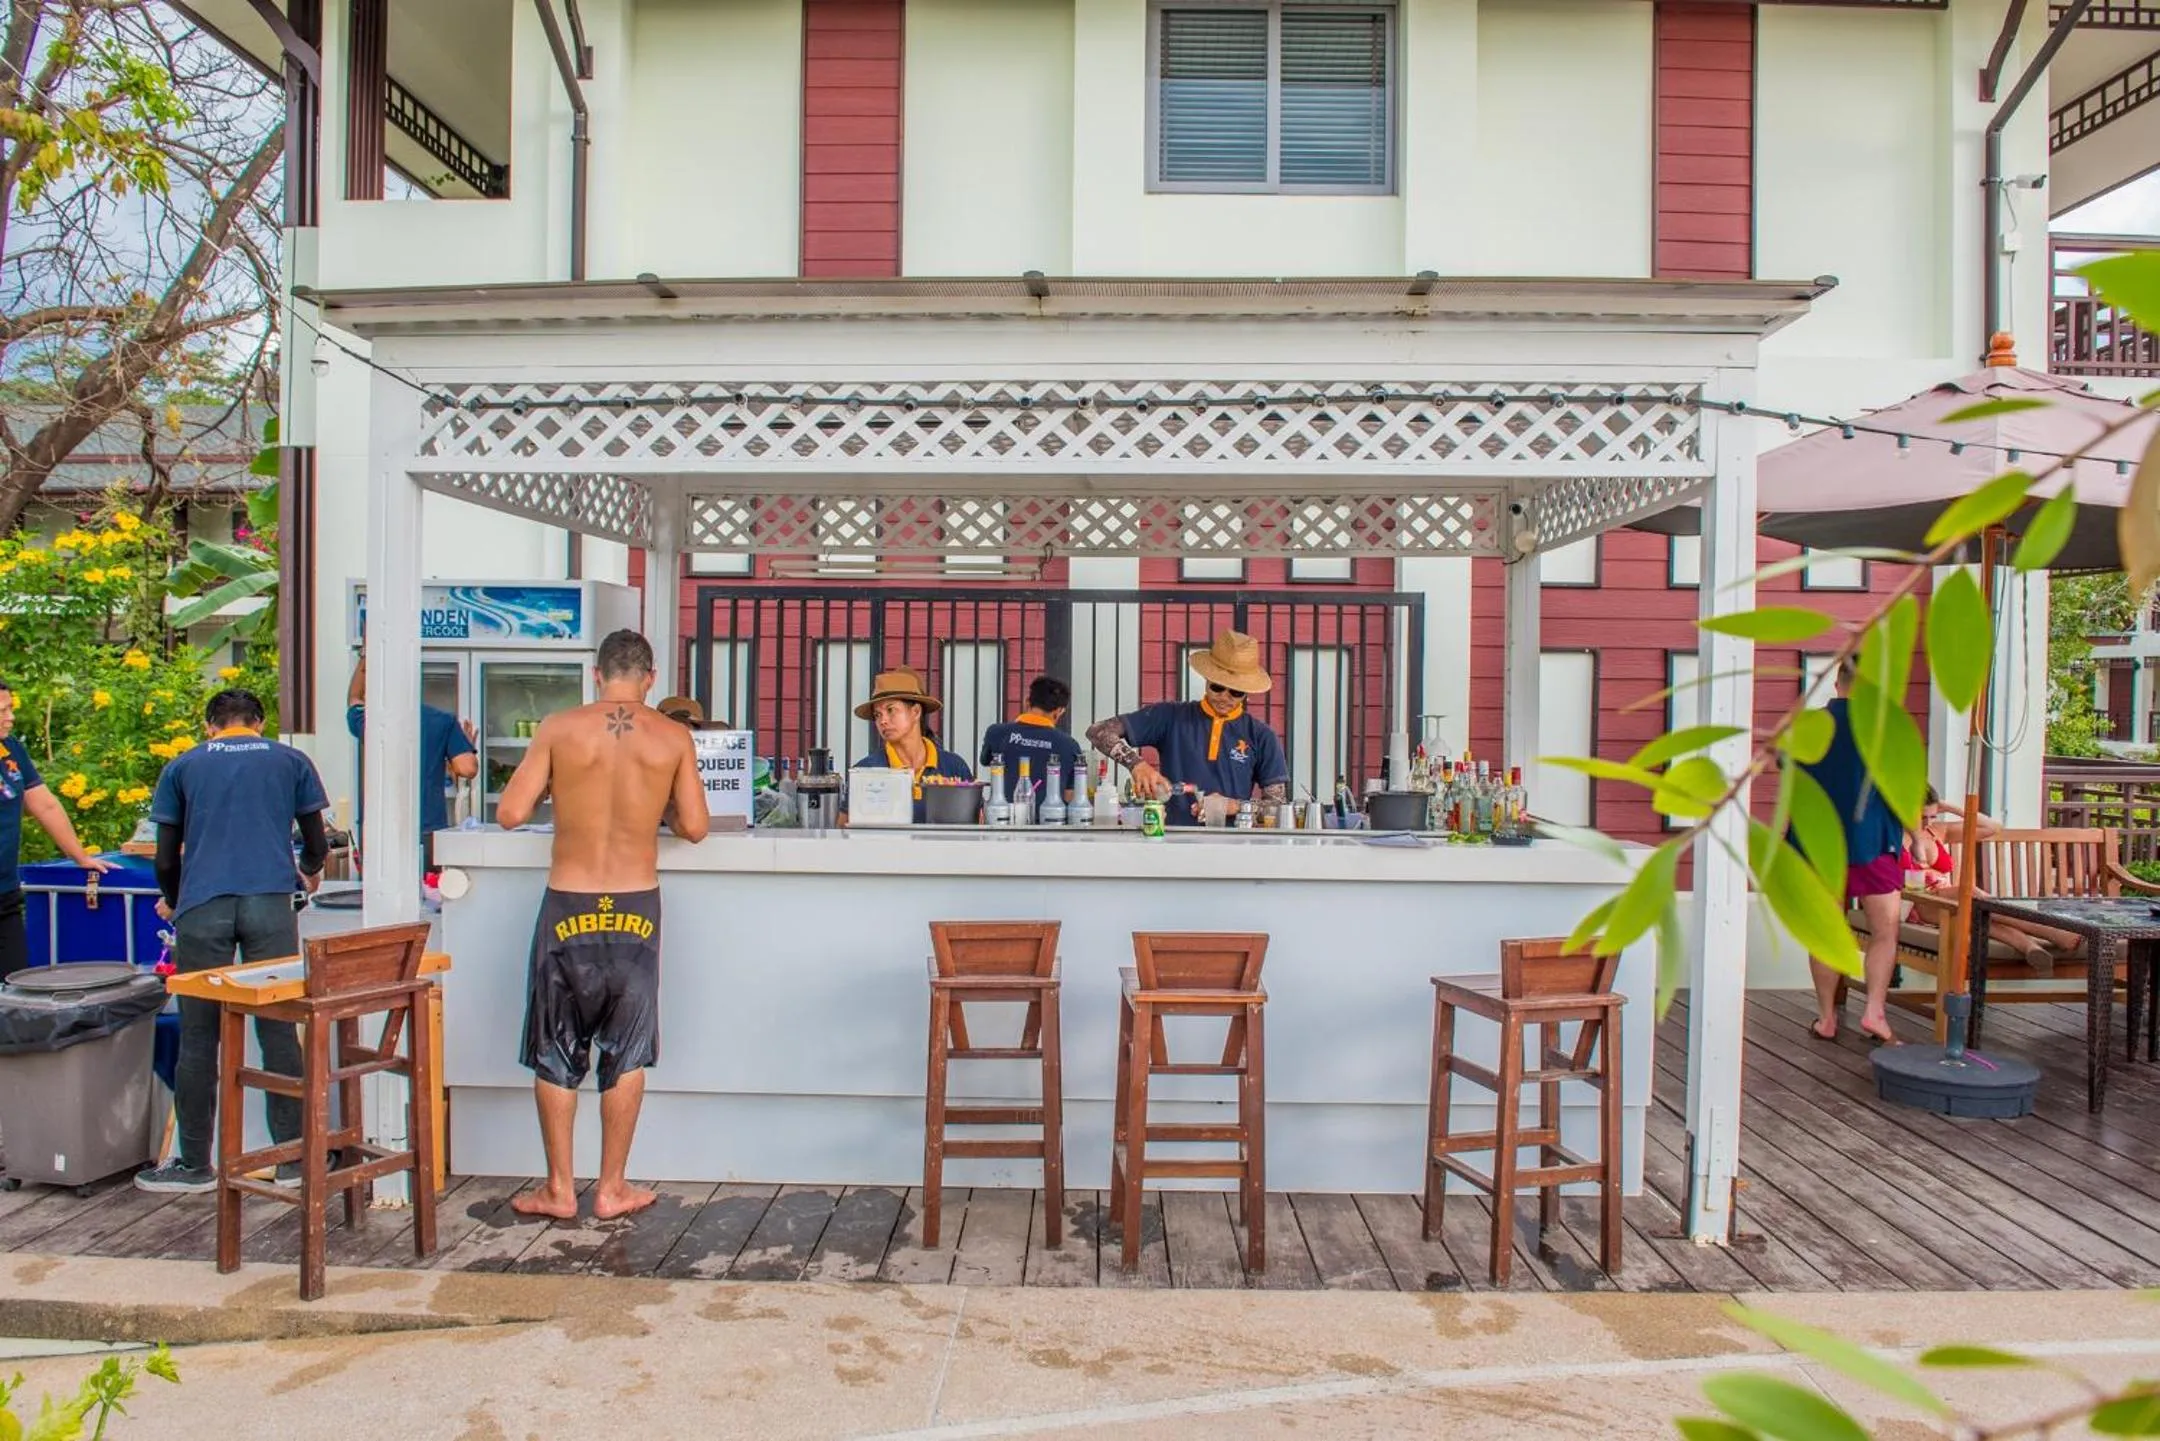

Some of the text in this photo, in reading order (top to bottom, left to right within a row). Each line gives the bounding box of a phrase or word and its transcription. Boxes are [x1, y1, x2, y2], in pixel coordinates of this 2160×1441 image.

[421, 609, 469, 625] NDEN
[421, 625, 467, 637] RCOOL
[697, 758, 746, 772] QUEUE
[703, 778, 741, 791] HERE
[555, 913, 654, 942] RIBEIRO
